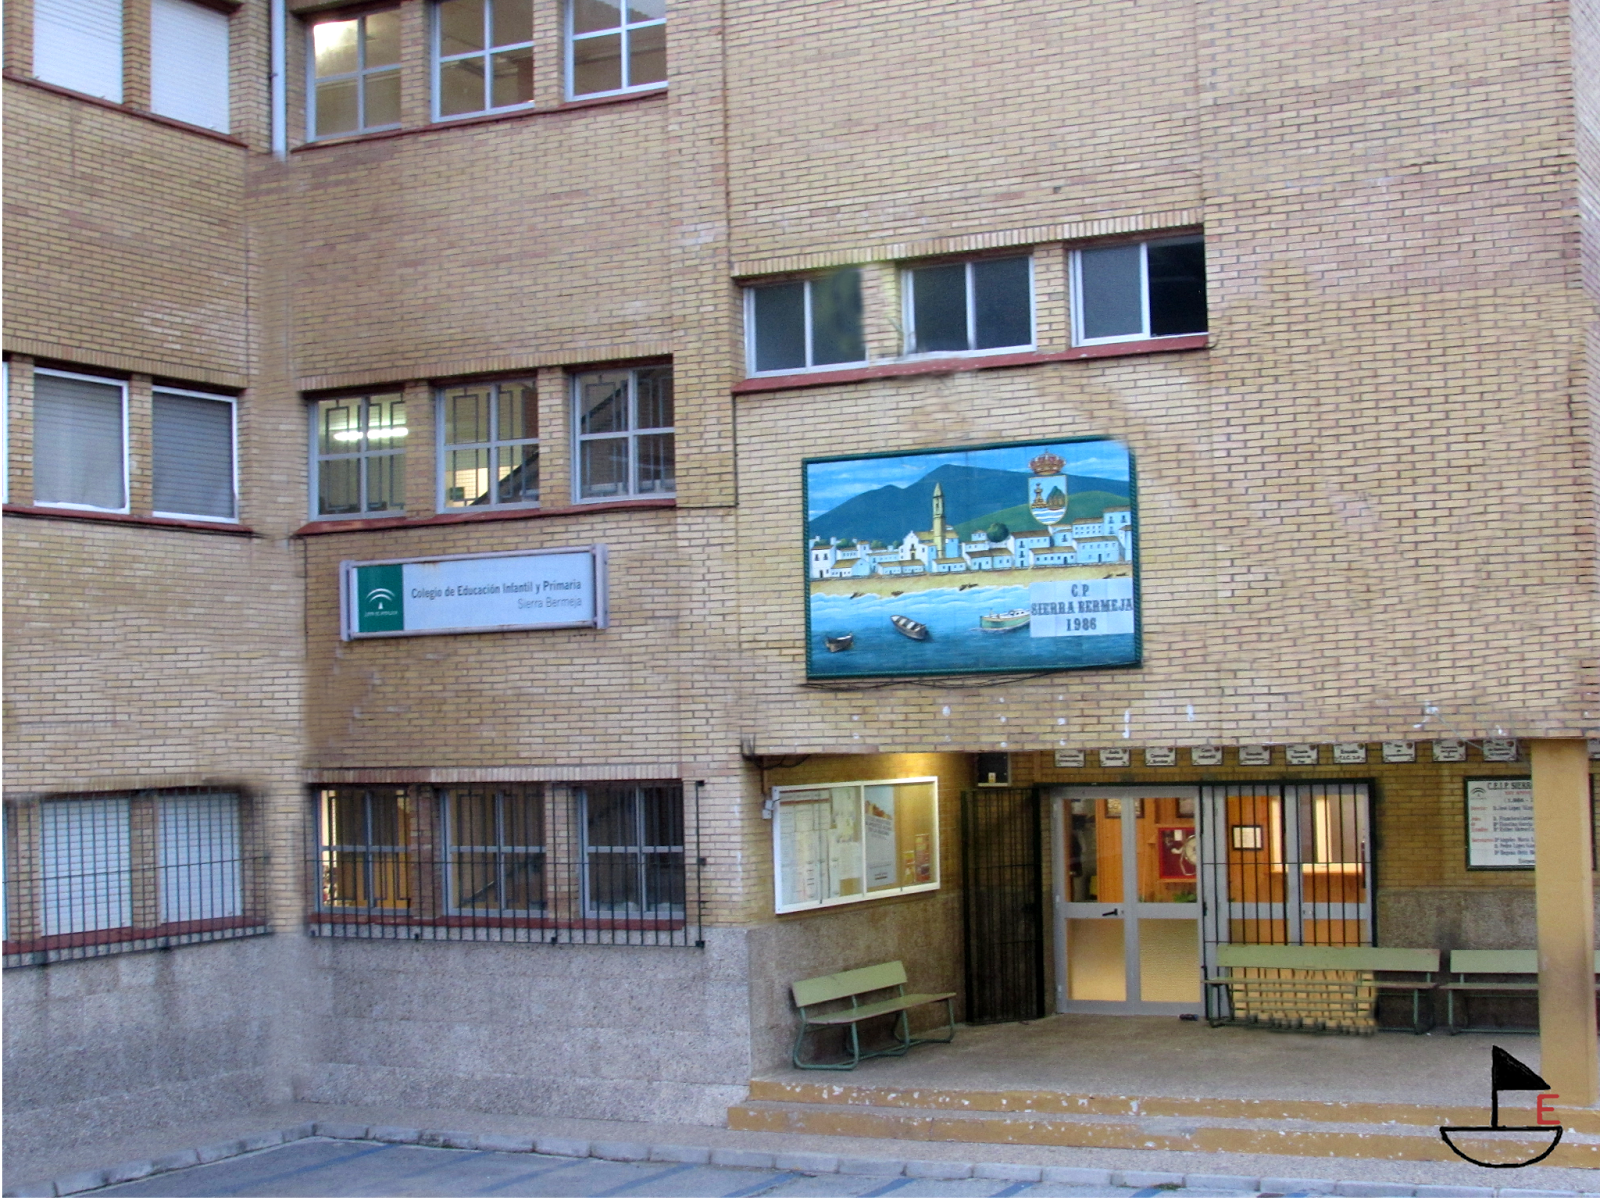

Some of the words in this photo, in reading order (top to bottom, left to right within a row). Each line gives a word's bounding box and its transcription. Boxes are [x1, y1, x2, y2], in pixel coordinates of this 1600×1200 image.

[411, 587, 442, 600] Colegio
[444, 586, 455, 596] de
[457, 584, 500, 596] Educación
[502, 581, 533, 593] Infantil
[535, 583, 541, 595] y
[543, 579, 582, 591] Primaria
[518, 598, 543, 609] Sierra
[546, 596, 582, 609] Bermeja
[1031, 601, 1075, 616] SIERRA
[1077, 598, 1134, 613] BERMEJA
[1066, 617, 1097, 632] 1986
